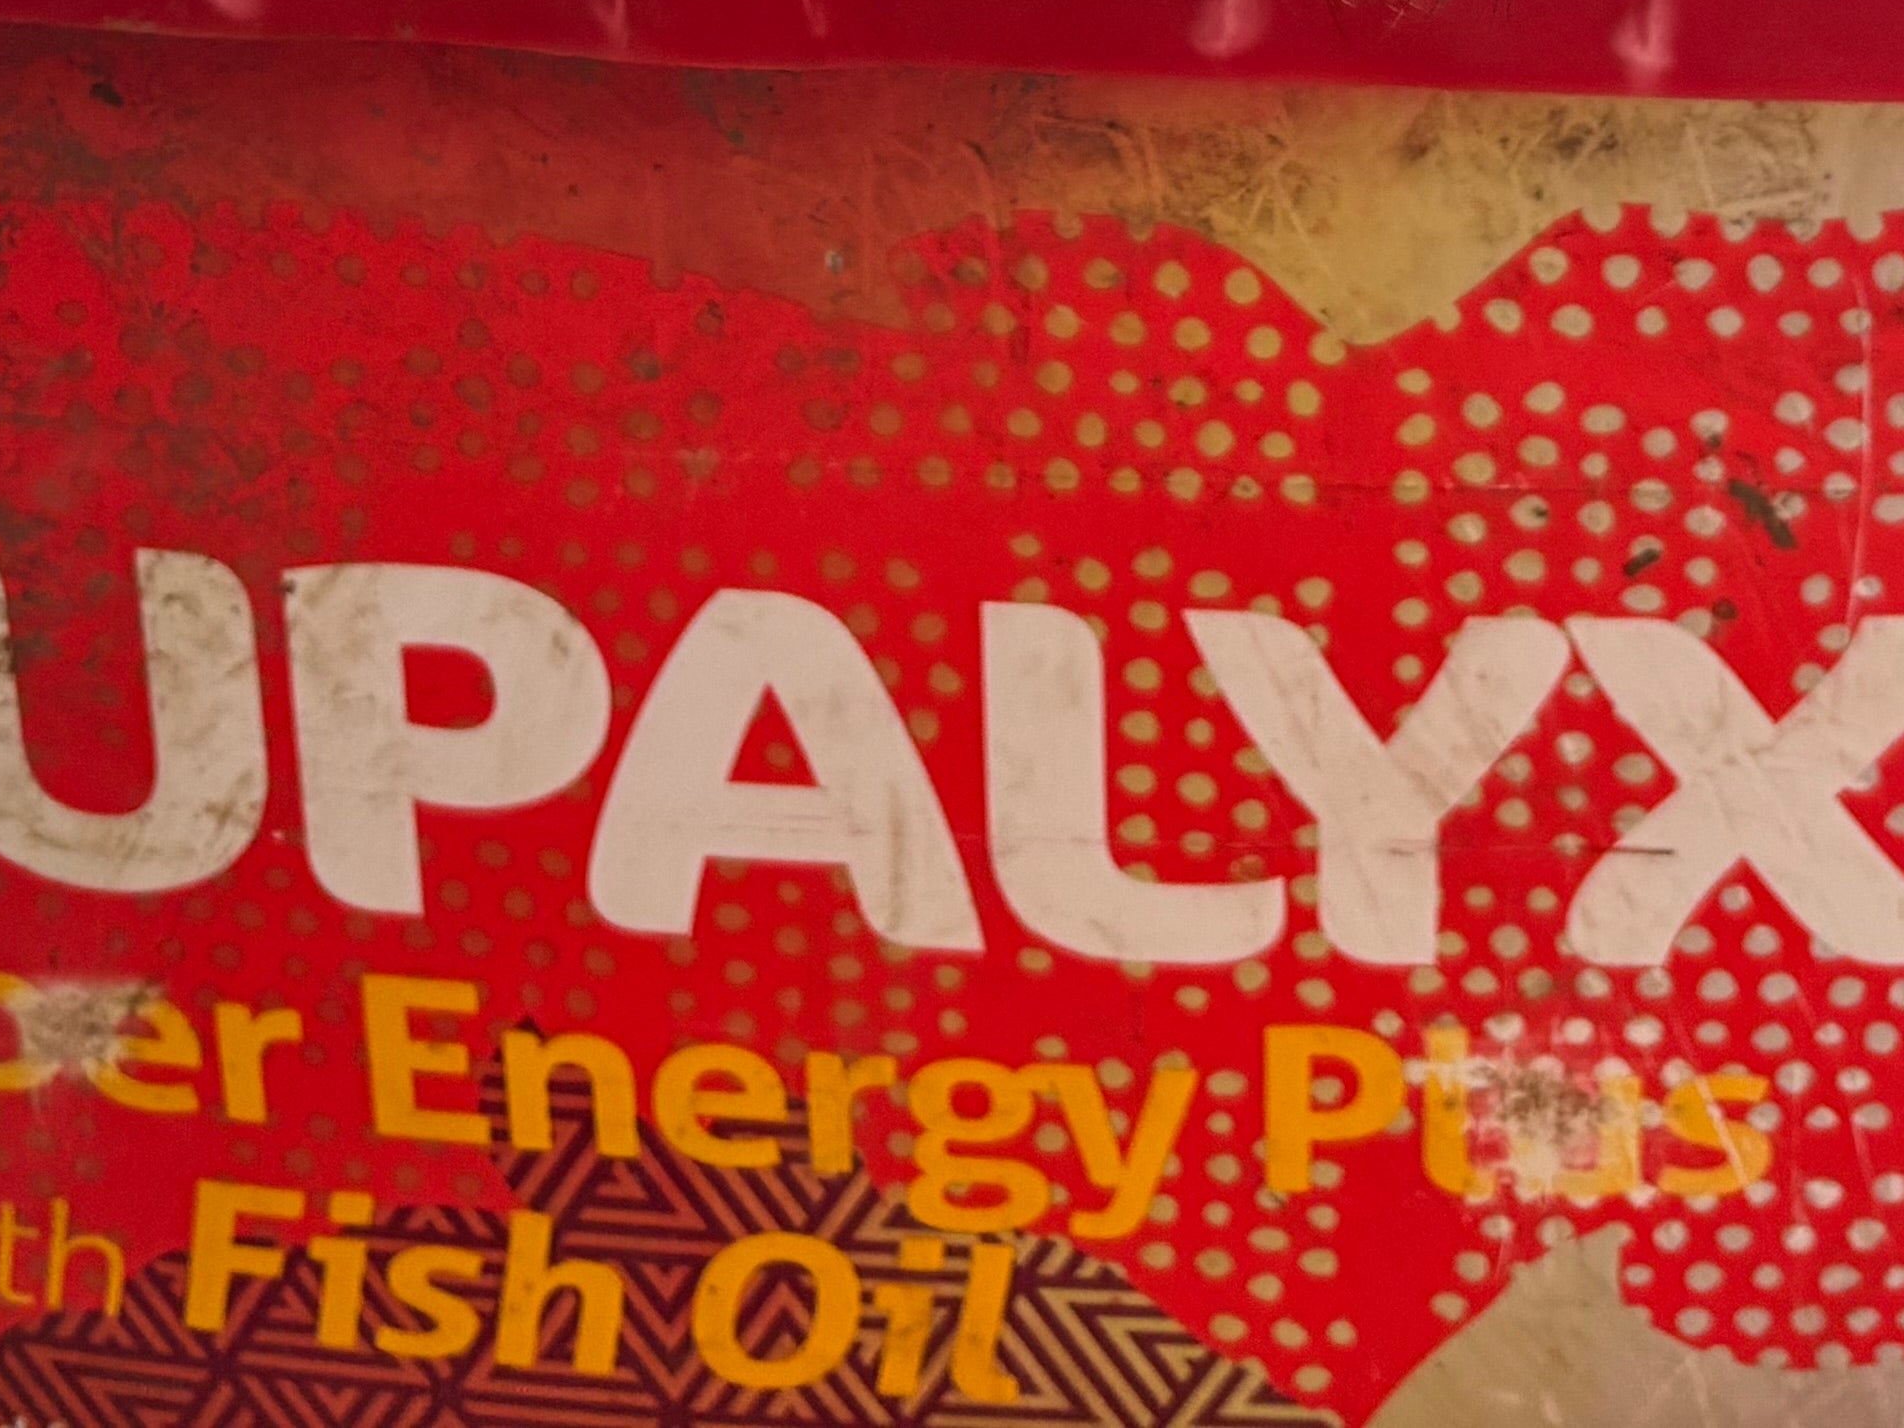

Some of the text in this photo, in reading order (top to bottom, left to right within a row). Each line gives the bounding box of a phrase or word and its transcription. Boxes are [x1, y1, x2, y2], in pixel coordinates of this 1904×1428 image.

[360, 973, 1199, 1239] Energy
[184, 1179, 624, 1376] Fish
[694, 1230, 1020, 1404] Oil
